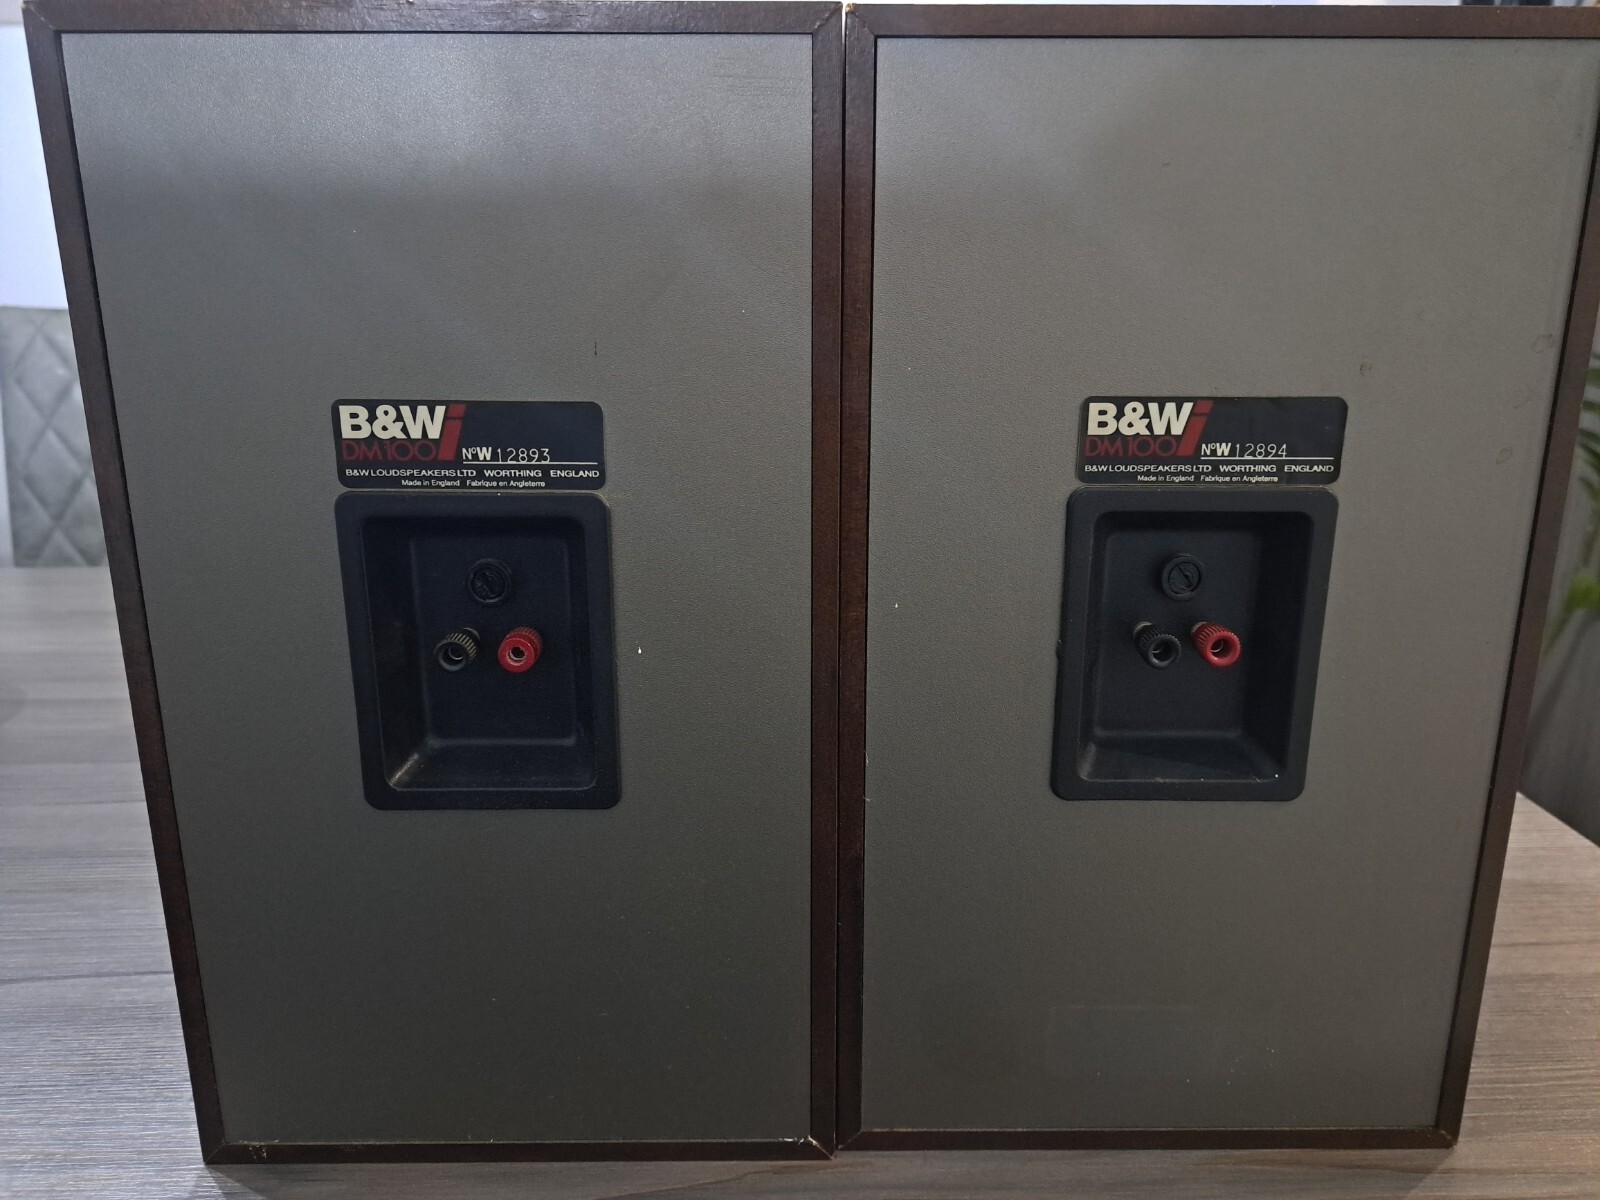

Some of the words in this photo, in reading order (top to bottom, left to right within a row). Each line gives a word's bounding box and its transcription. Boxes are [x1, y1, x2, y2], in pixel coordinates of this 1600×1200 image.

[338, 404, 447, 439] B&W
[1087, 401, 1194, 436] B&W
[496, 448, 551, 463] 12893
[1235, 443, 1288, 459] 12894
[1084, 464, 1109, 472] B&W
[1109, 464, 1193, 473] LOUDSPEAKERS
[1193, 464, 1212, 473] LTD
[1219, 464, 1277, 473] WORTHING
[1284, 464, 1334, 473] ENGLAND
[345, 469, 369, 477] B&W
[370, 469, 457, 477] LOUDSPEAKERS
[457, 469, 476, 477] LTD
[484, 469, 542, 478] WORTHING
[550, 469, 600, 478] ENGLAND
[1137, 474, 1157, 482] Made
[1158, 474, 1165, 482] in
[1166, 474, 1194, 483] England
[1200, 474, 1231, 483] Fabrique
[1242, 474, 1279, 483] Angleterre
[431, 479, 460, 488] England
[466, 479, 497, 488] Fabrique
[508, 479, 546, 488] Angleterre
